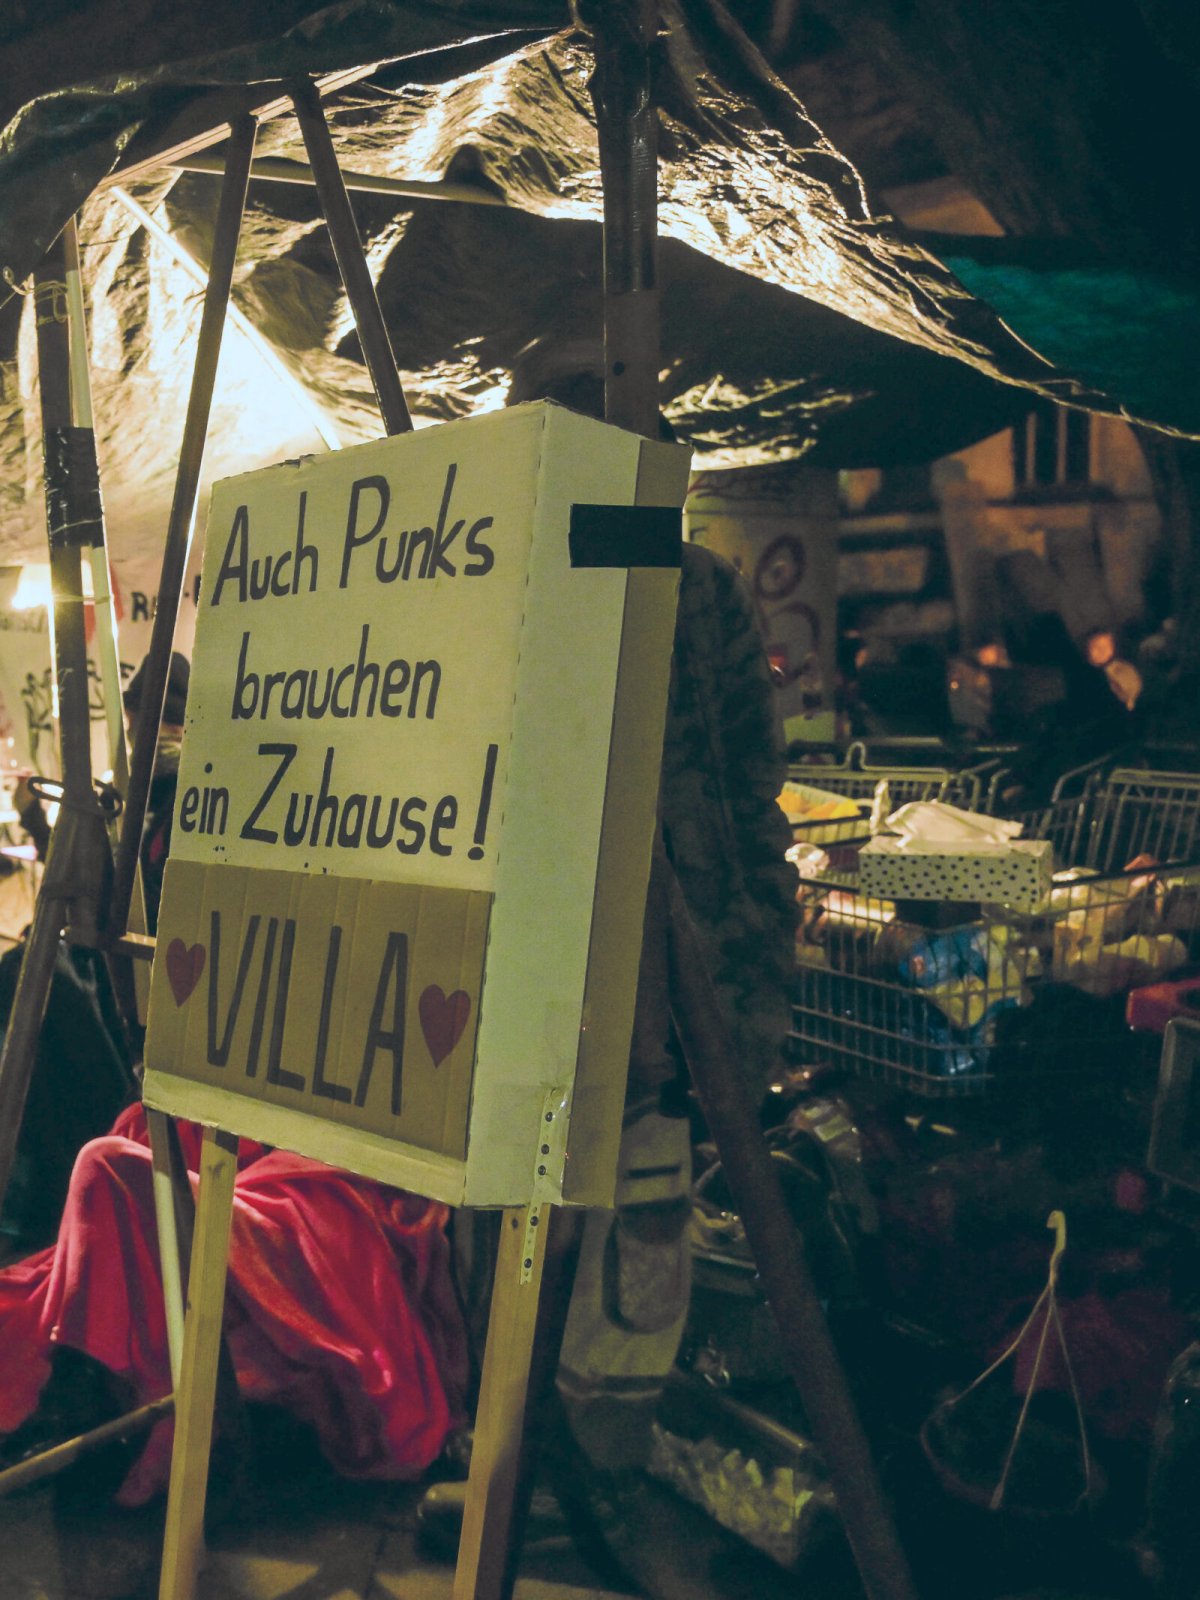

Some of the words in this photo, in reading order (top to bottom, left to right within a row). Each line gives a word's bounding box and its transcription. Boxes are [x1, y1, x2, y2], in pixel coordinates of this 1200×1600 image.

[211, 491, 318, 606] Auch
[339, 464, 496, 590] Punks
[231, 623, 442, 721] brauchen
[179, 762, 228, 837] ein
[240, 743, 499, 860] Zuhause!
[205, 910, 409, 1116] VILLA
